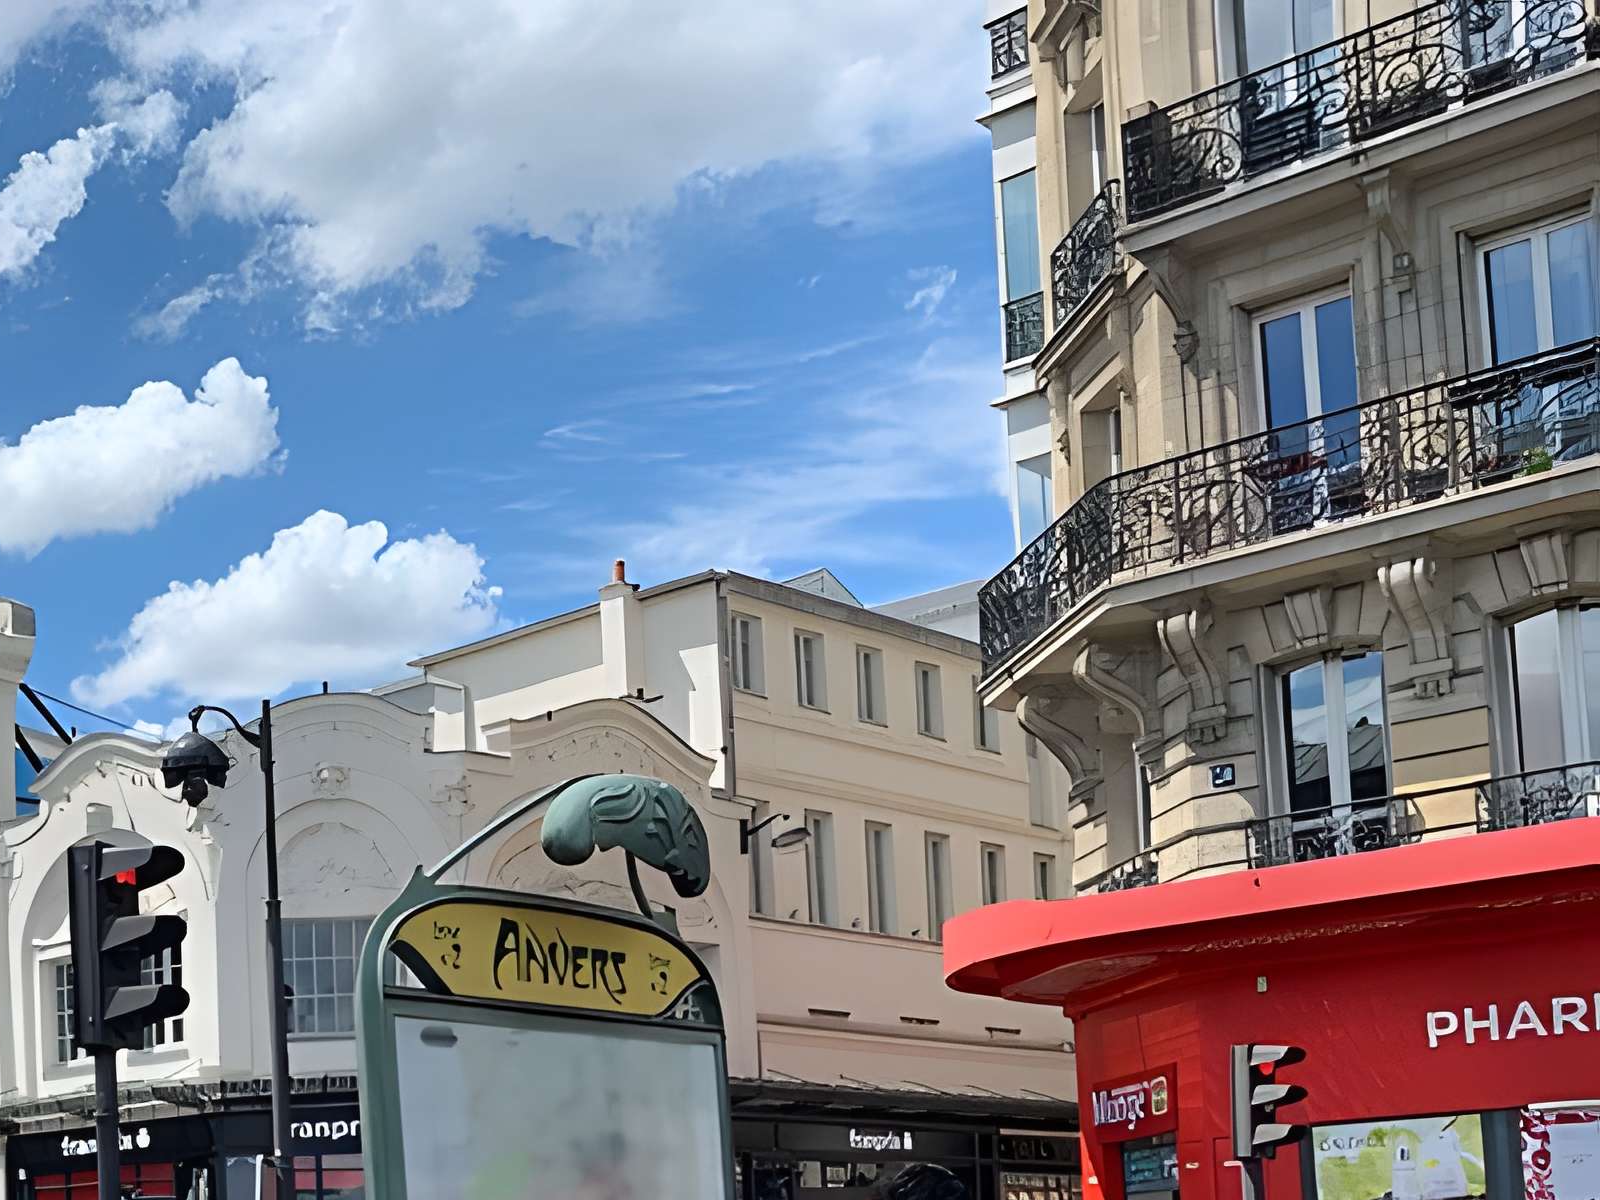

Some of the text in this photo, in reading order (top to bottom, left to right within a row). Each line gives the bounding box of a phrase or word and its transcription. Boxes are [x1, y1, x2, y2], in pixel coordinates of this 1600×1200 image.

[492, 917, 628, 1006] ANVERS
[1426, 992, 1600, 1048] PHAR
[290, 1120, 361, 1141] ranpr
